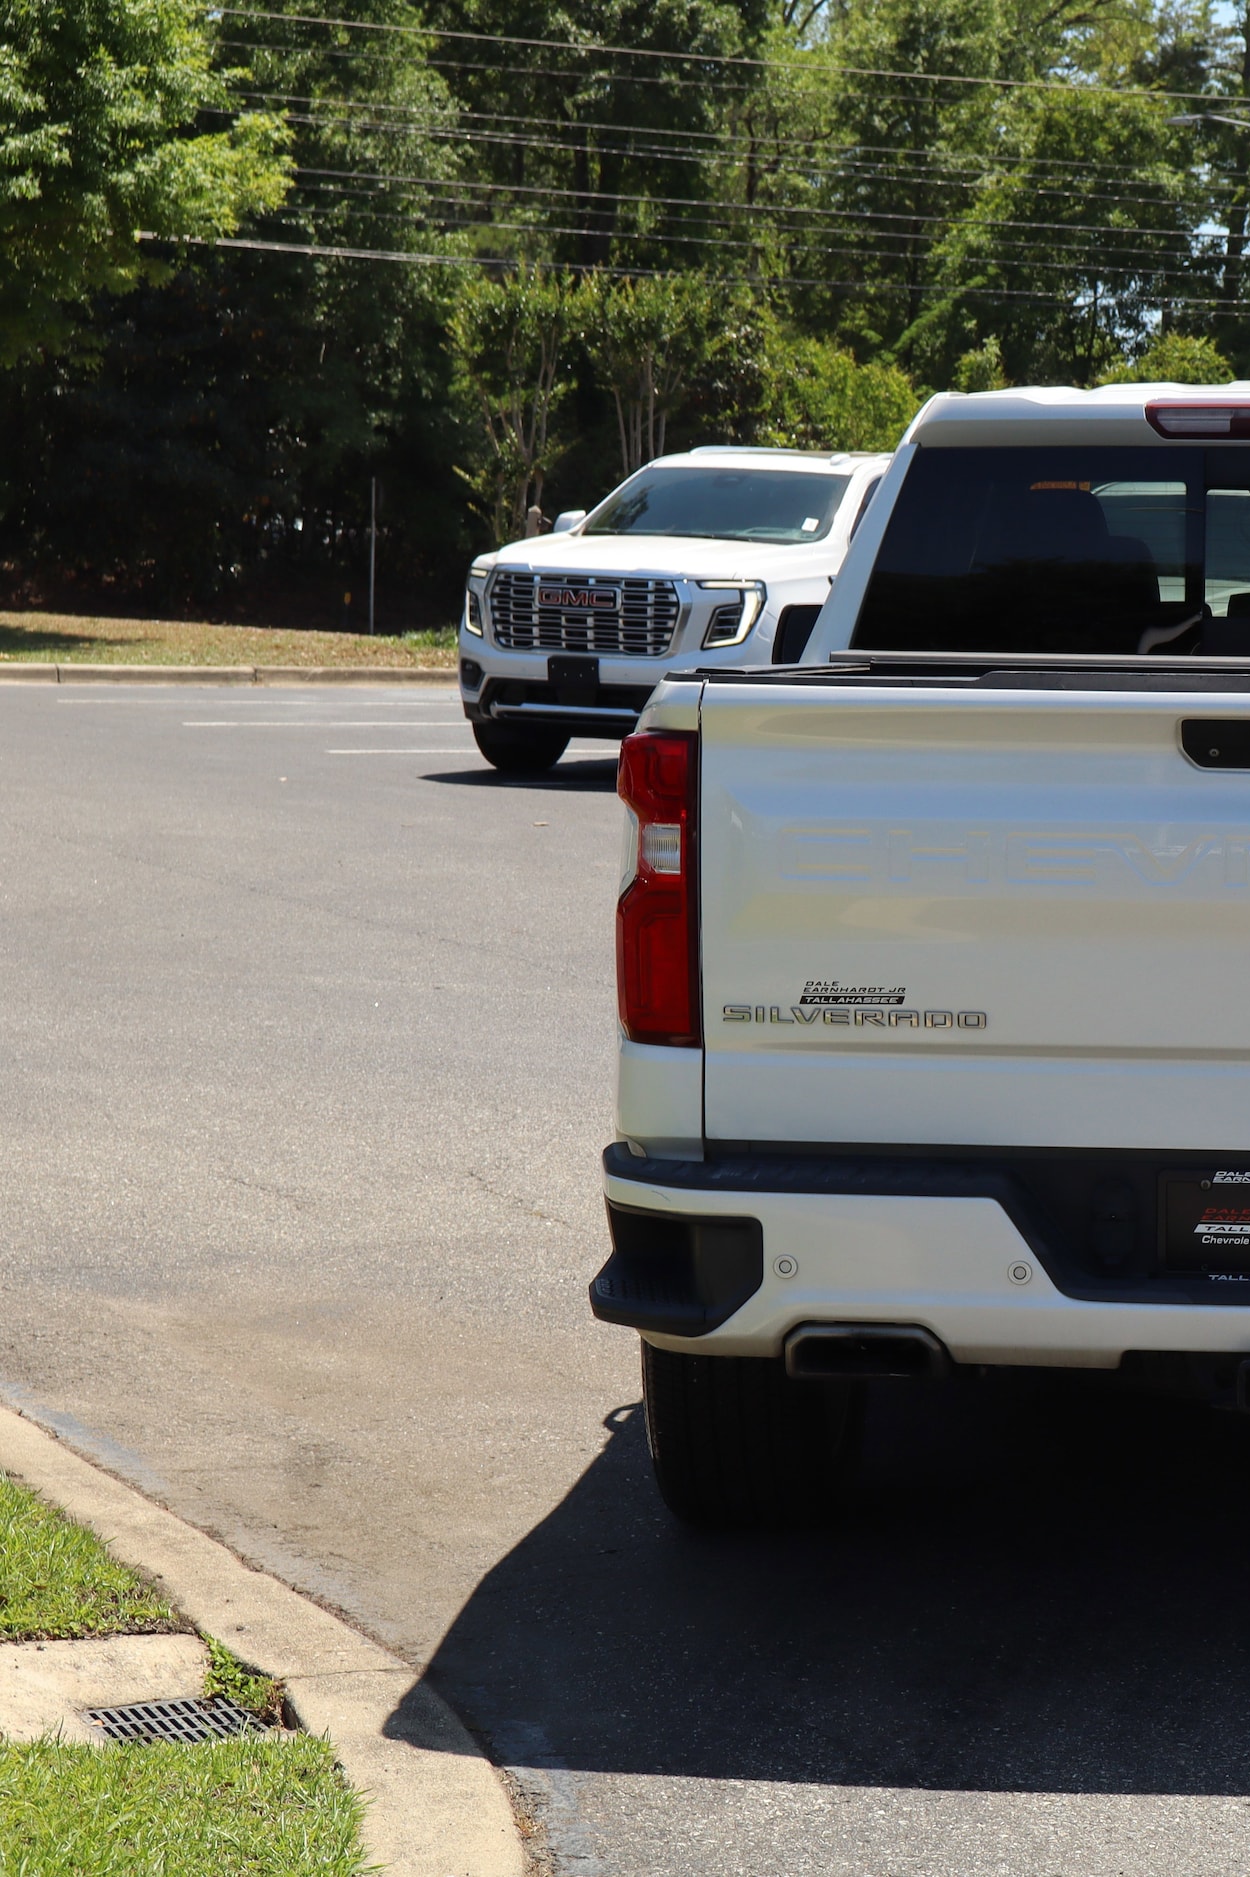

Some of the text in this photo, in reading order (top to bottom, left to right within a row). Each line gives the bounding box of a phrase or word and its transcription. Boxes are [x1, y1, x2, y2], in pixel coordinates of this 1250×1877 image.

[540, 588, 614, 607] GMC
[805, 996, 899, 1004] TALLAHASSEE
[723, 1004, 987, 1029] SILVERADO
